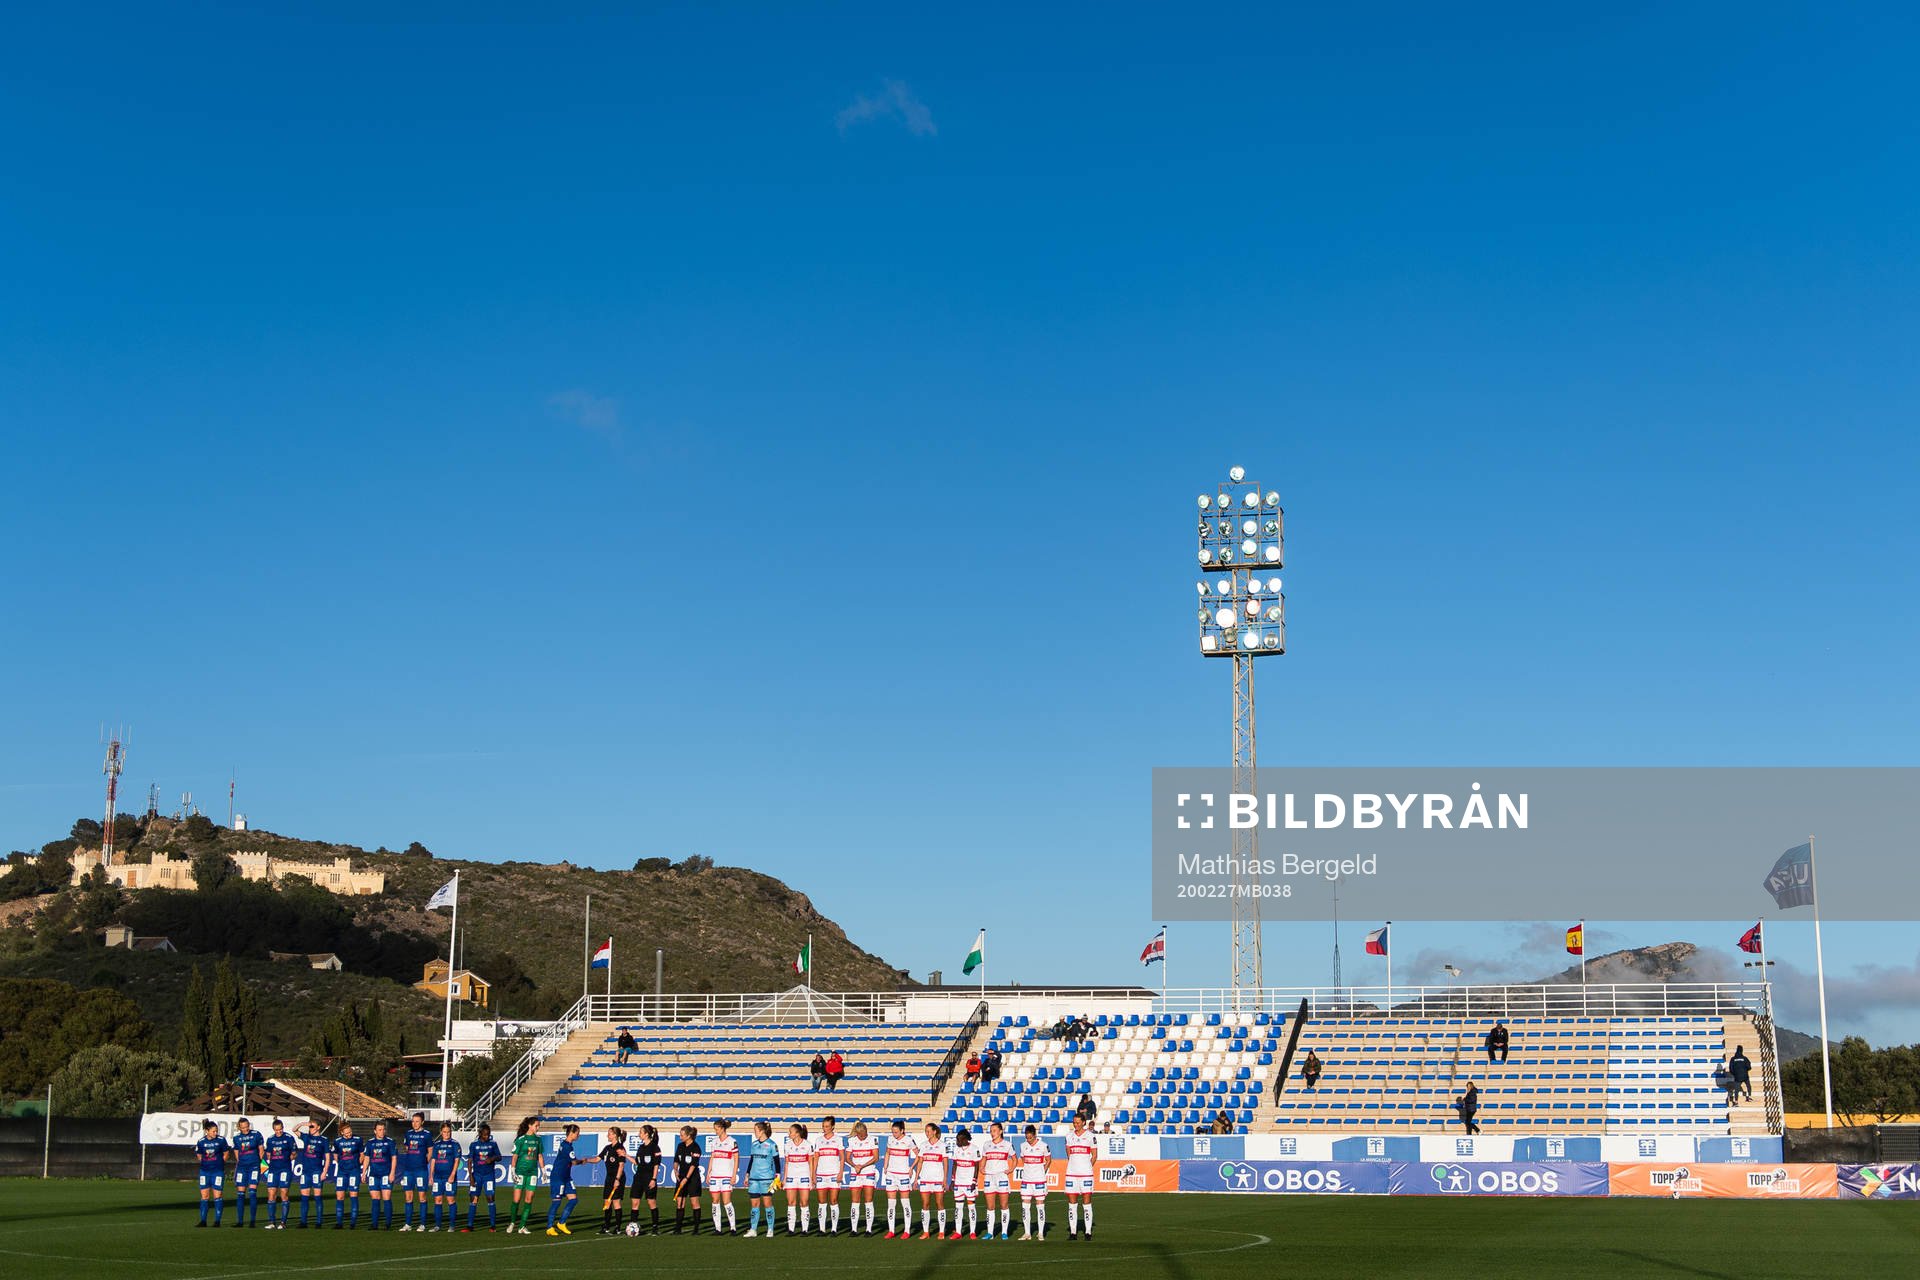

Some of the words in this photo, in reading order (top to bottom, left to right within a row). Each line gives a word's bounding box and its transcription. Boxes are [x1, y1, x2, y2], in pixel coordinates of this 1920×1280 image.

[1102, 1169, 1122, 1181] TOPP
[1120, 1176, 1144, 1185] SERIEN
[1263, 1169, 1341, 1190] OBOS
[1652, 1173, 1675, 1184] TOPP
[1750, 1174, 1772, 1186] TOPP
[1478, 1171, 1559, 1192] OBOS
[1673, 1180, 1699, 1190] SERIEN
